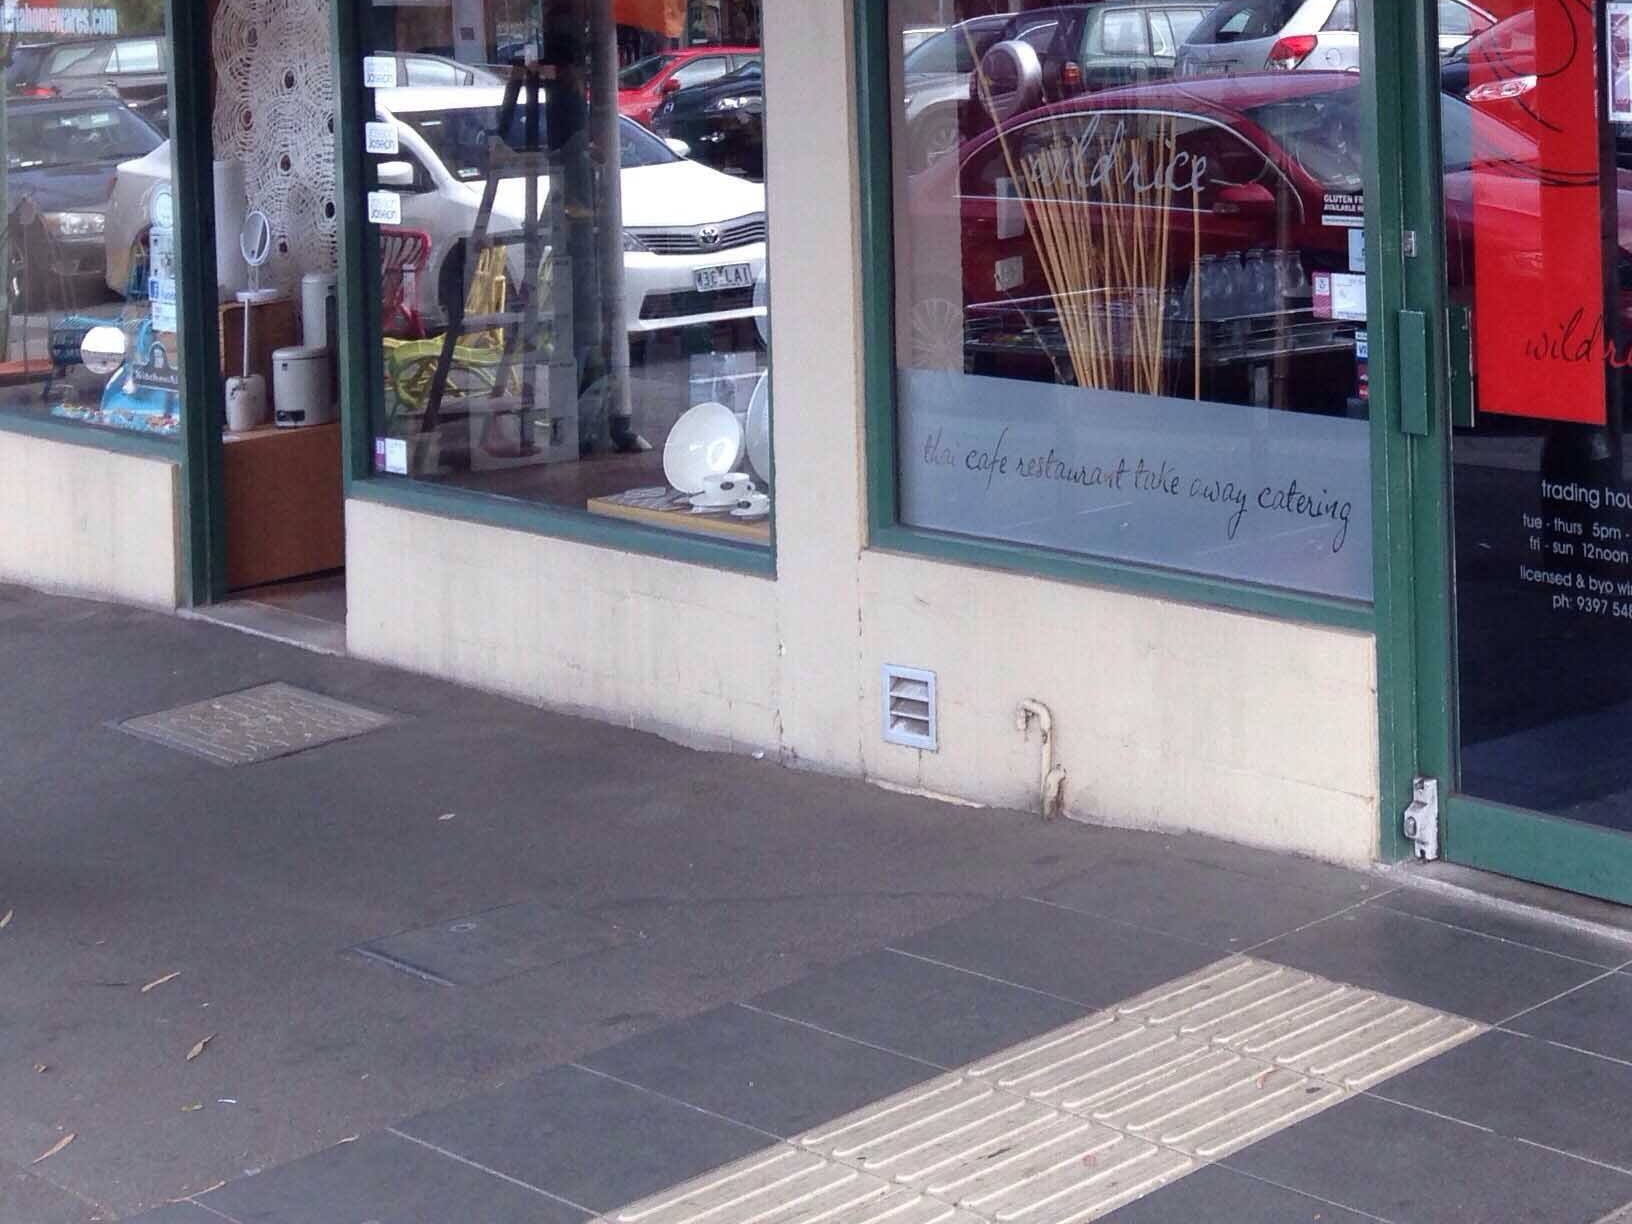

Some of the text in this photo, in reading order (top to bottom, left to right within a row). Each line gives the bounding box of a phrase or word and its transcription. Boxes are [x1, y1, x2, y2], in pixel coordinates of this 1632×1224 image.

[1028, 113, 1207, 194] wild rice
[1526, 307, 1603, 363] wild
[921, 425, 1353, 553] thai cafe restaurant take away catering
[1541, 479, 1600, 509] trading
[1522, 512, 1543, 529] tue
[1554, 516, 1583, 536] thurs
[1592, 522, 1622, 542] 5pm
[1529, 535, 1541, 552] fri
[1552, 540, 1574, 556] sun
[1582, 542, 1629, 564] 12noon
[1520, 565, 1573, 587] licensed
[1576, 573, 1585, 589] &
[1588, 575, 1614, 594] byo
[1552, 593, 1573, 609] ph:
[1577, 596, 1608, 615] 9397
